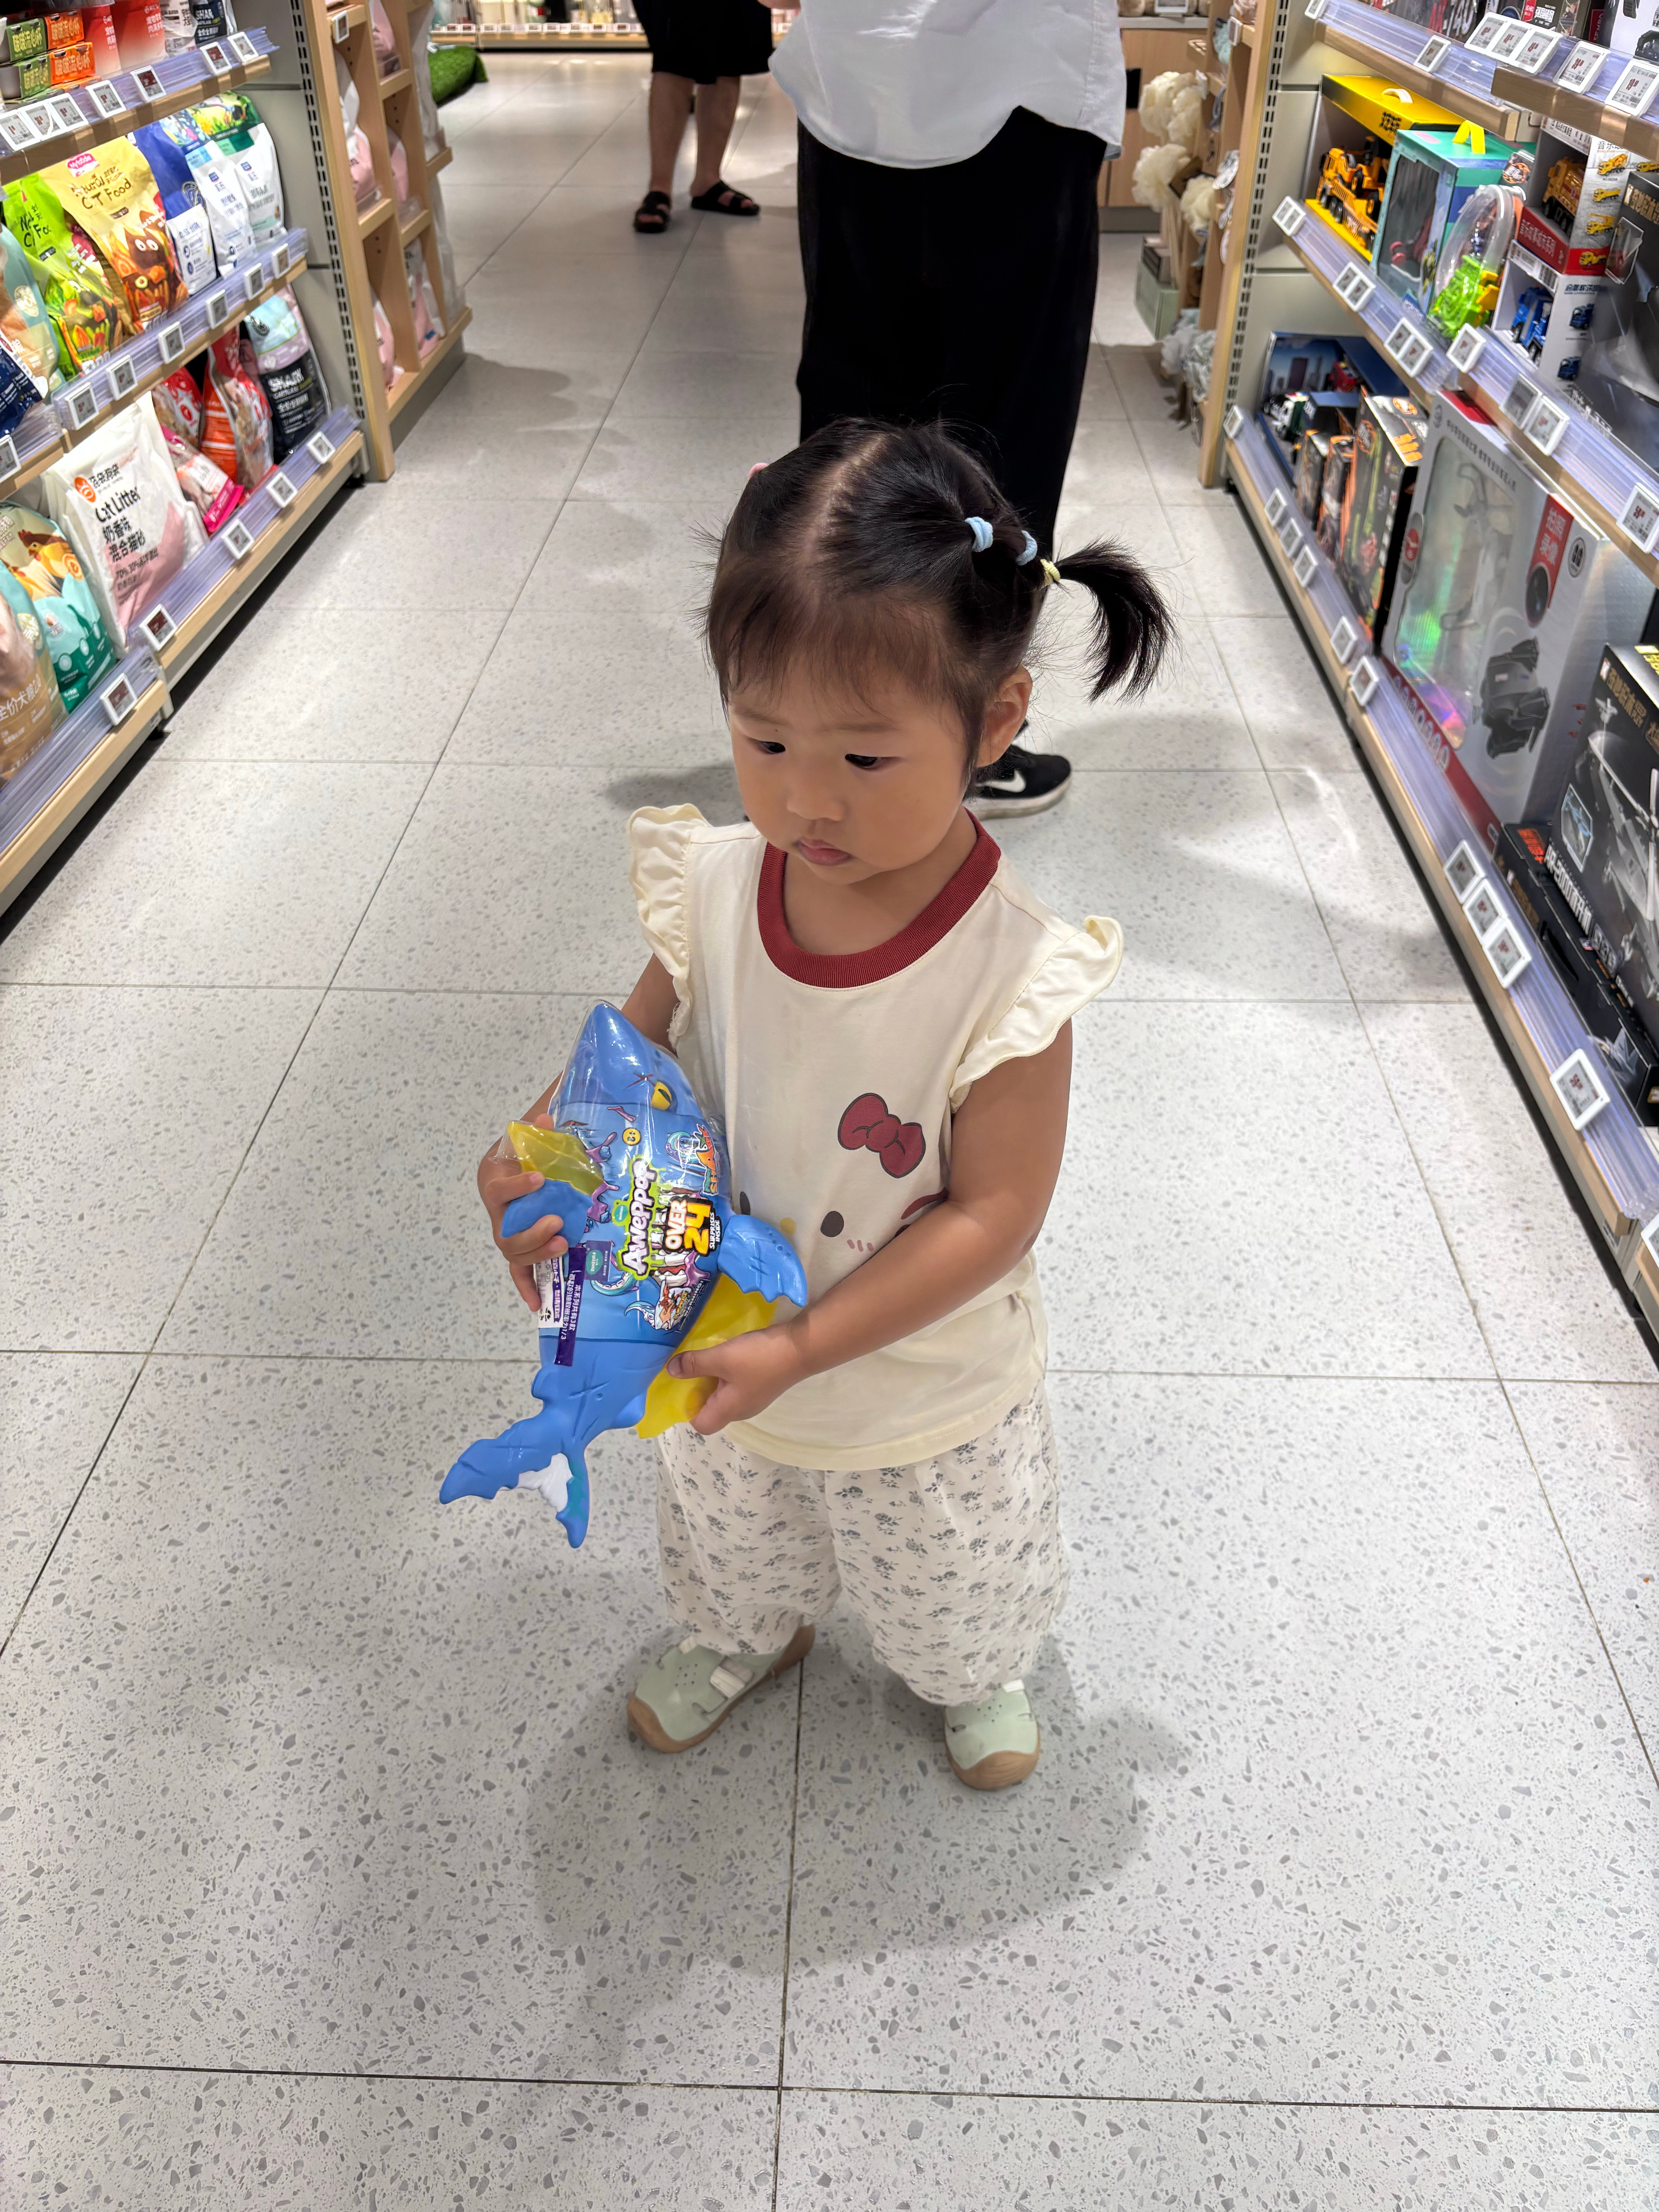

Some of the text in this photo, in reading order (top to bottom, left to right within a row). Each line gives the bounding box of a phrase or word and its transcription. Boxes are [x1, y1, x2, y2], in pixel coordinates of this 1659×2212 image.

[111, 486, 141, 513] Litter
[665, 1199, 688, 1250] OVER
[684, 1202, 711, 1255] 24
